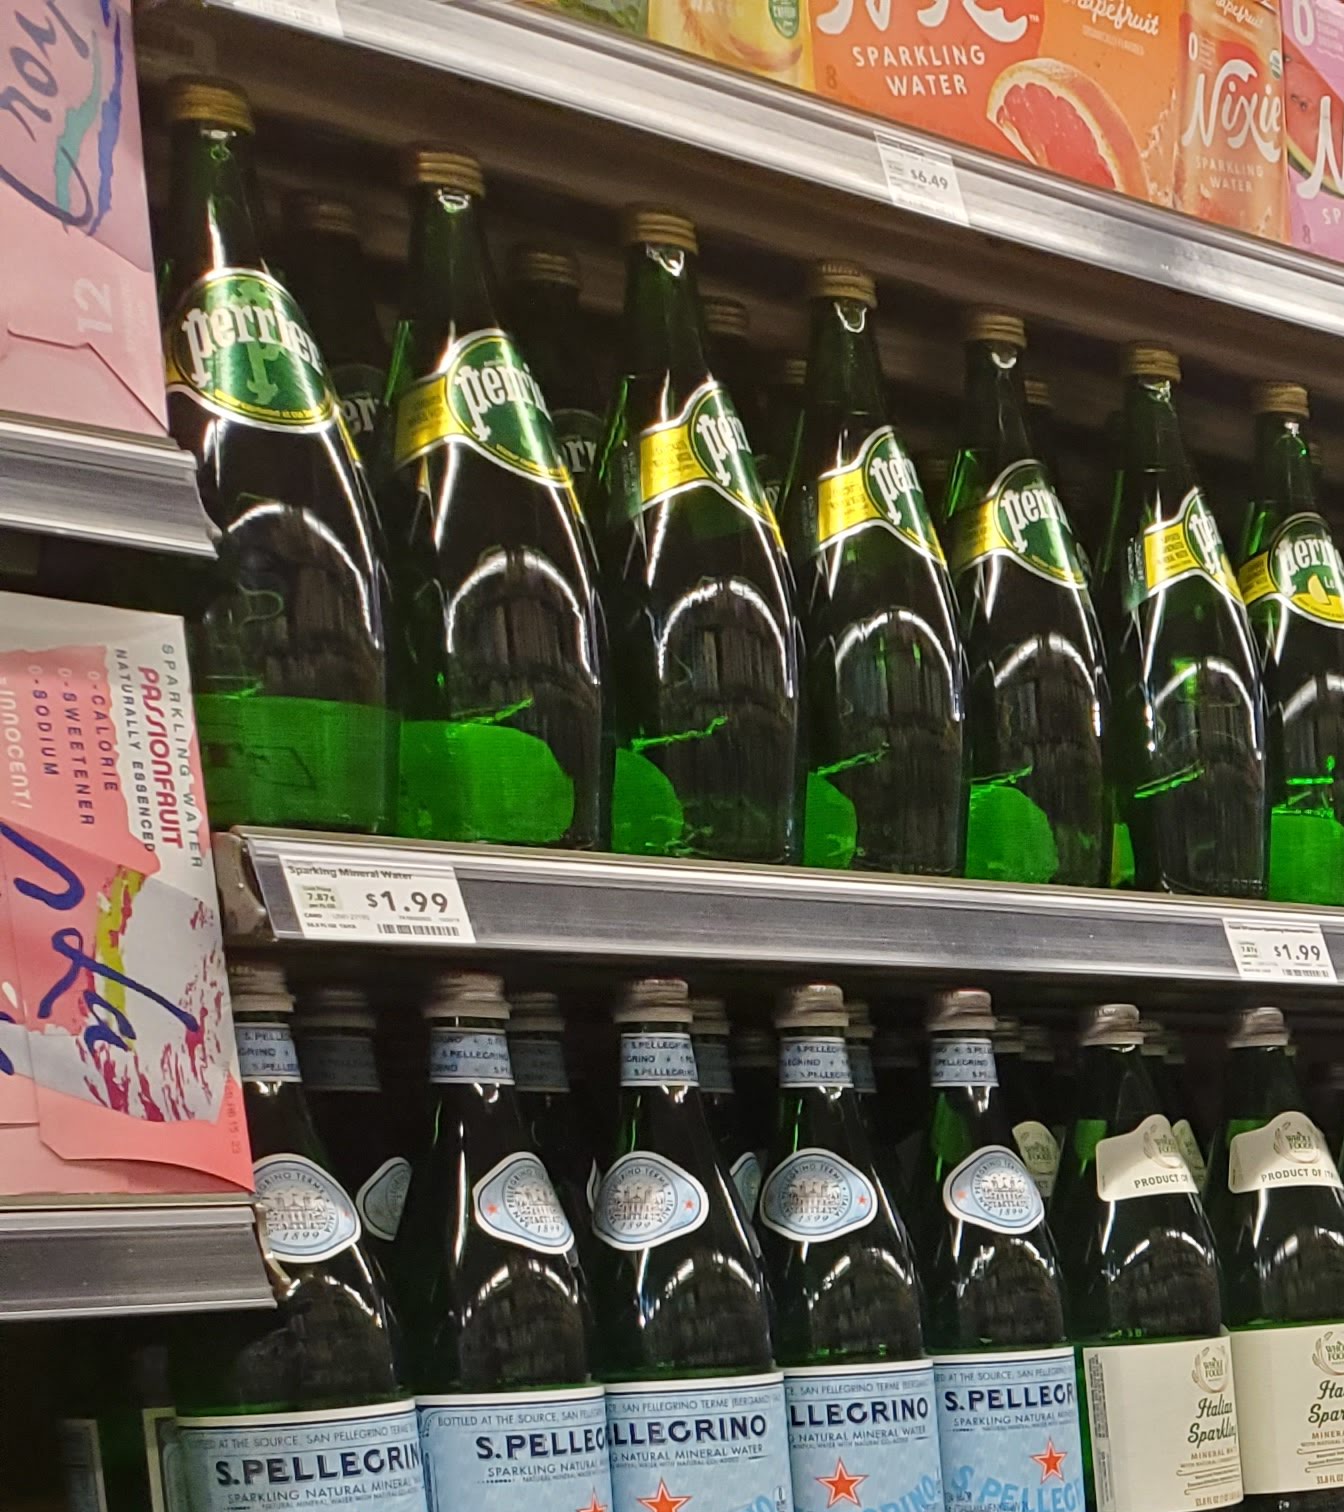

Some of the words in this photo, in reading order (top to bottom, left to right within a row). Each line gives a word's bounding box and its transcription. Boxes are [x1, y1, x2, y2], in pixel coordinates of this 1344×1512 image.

[852, 44, 986, 68] SPARKLING
[885, 74, 969, 97] WATER
[1182, 57, 1282, 163] Nixie
[911, 168, 948, 190] $6.49
[114, 648, 142, 750] NATURALLY
[132, 761, 156, 852] ESSENCED
[162, 643, 194, 778] SPARKLING
[183, 792, 203, 868] WATER
[338, 868, 379, 878] Mineral
[380, 870, 413, 880] Water
[366, 890, 448, 914] $1.99
[1274, 943, 1321, 963] $1.99
[1134, 1175, 1173, 1190] PRODUCT
[622, 1403, 639, 1413] SAN
[643, 1400, 698, 1412] PELLEGRINO
[701, 1398, 729, 1409] TERME
[437, 1416, 477, 1427] BOTTLED
[306, 1434, 330, 1445] SAN
[334, 1428, 387, 1441] PELLEGRINO
[621, 1452, 670, 1463] NATURAL
[675, 1448, 727, 1460] MINERAL
[732, 1443, 763, 1456] WATER
